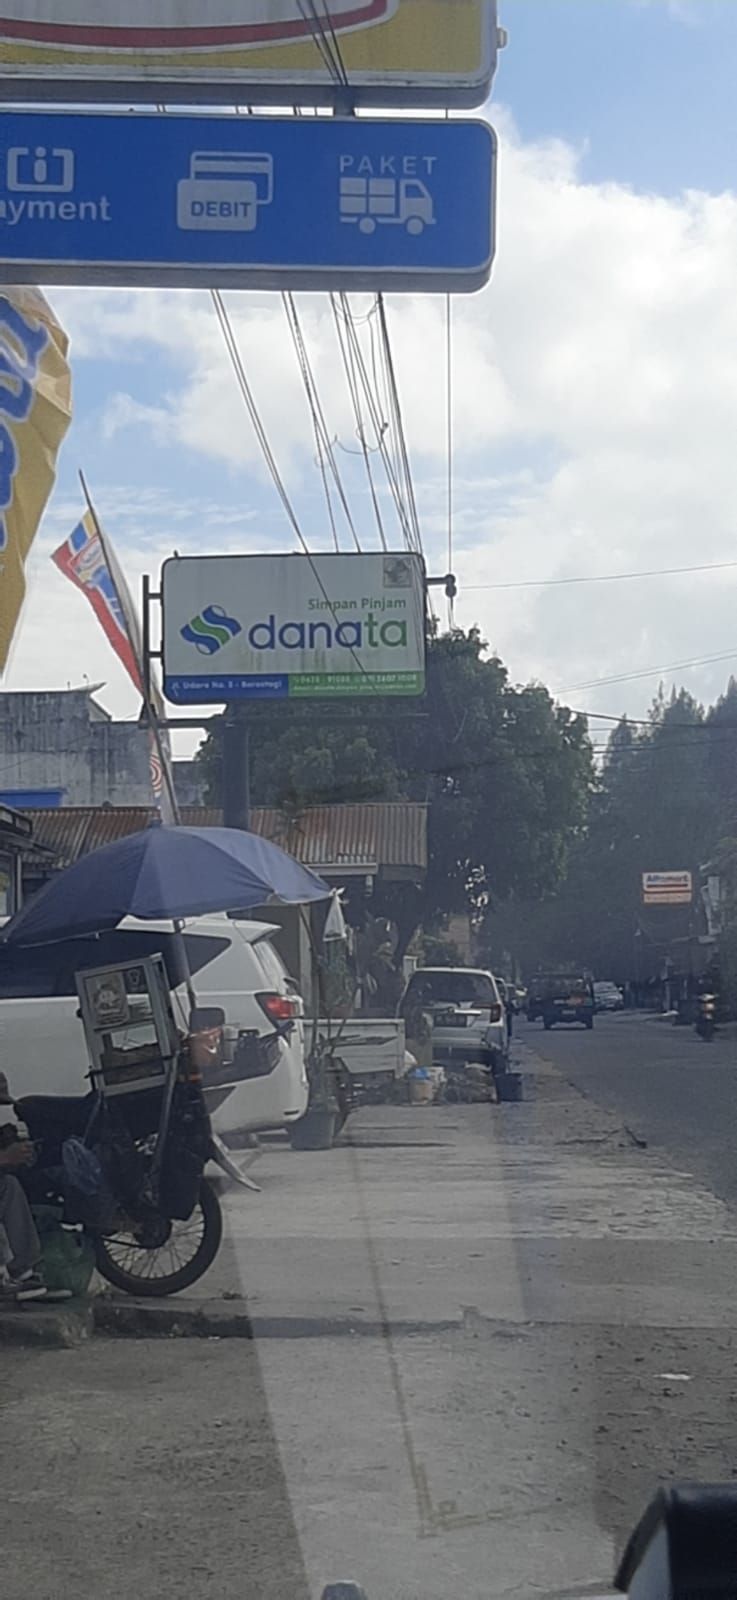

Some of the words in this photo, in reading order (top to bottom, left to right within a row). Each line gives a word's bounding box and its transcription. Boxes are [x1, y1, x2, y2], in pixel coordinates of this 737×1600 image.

[338, 154, 438, 176] PAKET
[190, 200, 252, 218] DEBIT
[307, 597, 357, 614] Simpan
[360, 596, 407, 612] Pinjam
[248, 612, 408, 650] danata
